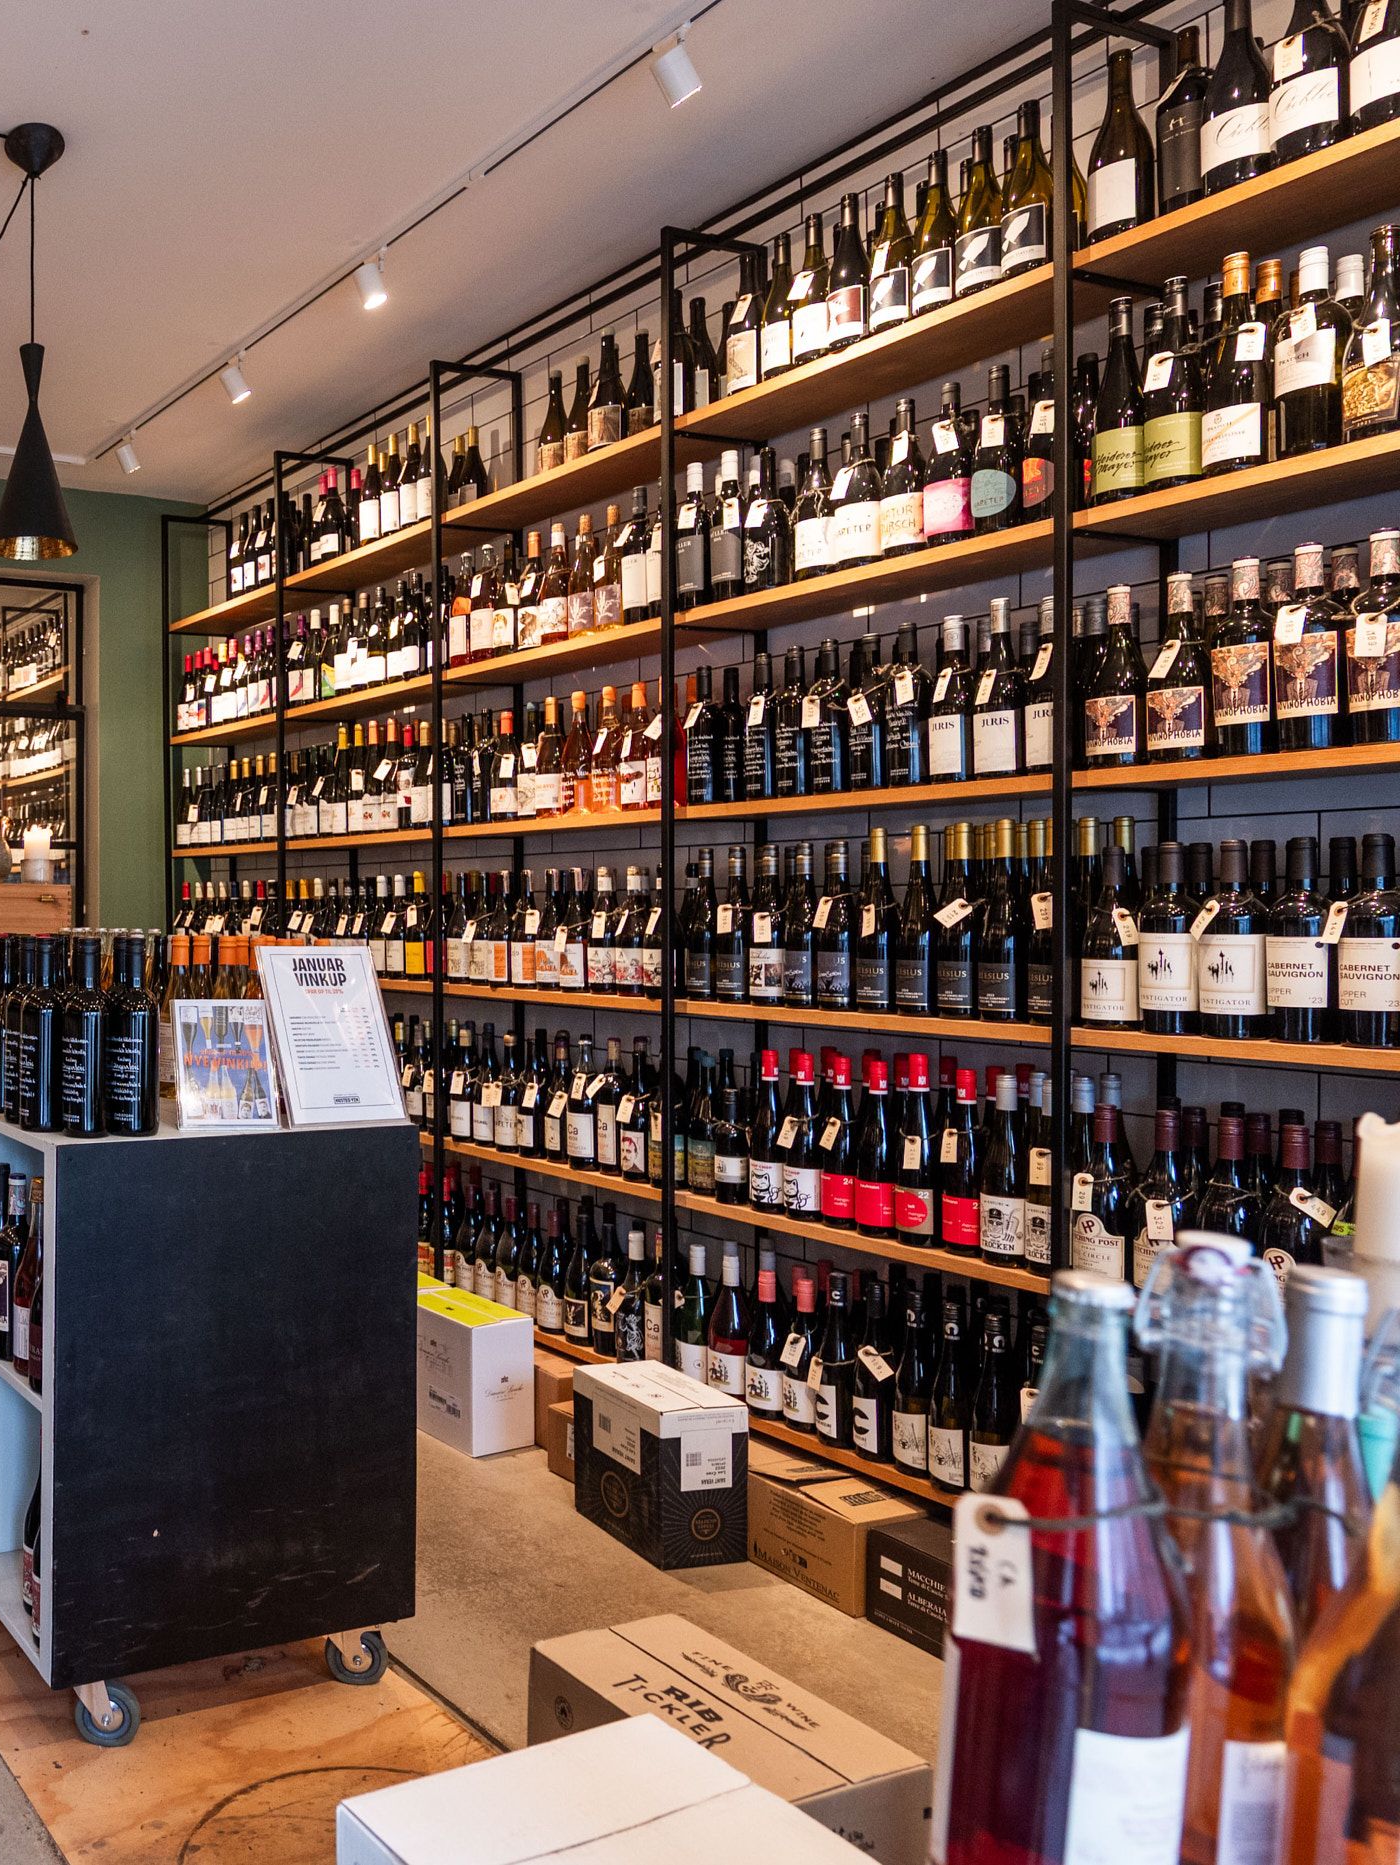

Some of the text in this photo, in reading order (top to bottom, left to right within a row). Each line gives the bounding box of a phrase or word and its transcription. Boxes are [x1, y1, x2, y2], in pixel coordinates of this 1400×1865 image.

[932, 721, 955, 732] JURIS
[981, 717, 1010, 728] JURIS
[292, 957, 346, 972] JANUAR
[1267, 962, 1315, 971] CABERNET
[1340, 964, 1391, 972] CABERNET
[294, 972, 348, 987] VINKUP
[1267, 970, 1324, 979] SAUVIGNON
[1340, 972, 1400, 981] SAUVIGNON
[917, 1191, 930, 1200] 22
[1098, 1239, 1120, 1247] POST
[756, 1548, 841, 1600] MAISON VENTENAC
[907, 1567, 947, 1593] MACCHIE
[692, 1651, 821, 1729] FINE WINE
[662, 1685, 724, 1723] RIB
[612, 1673, 732, 1750] TICKLER
